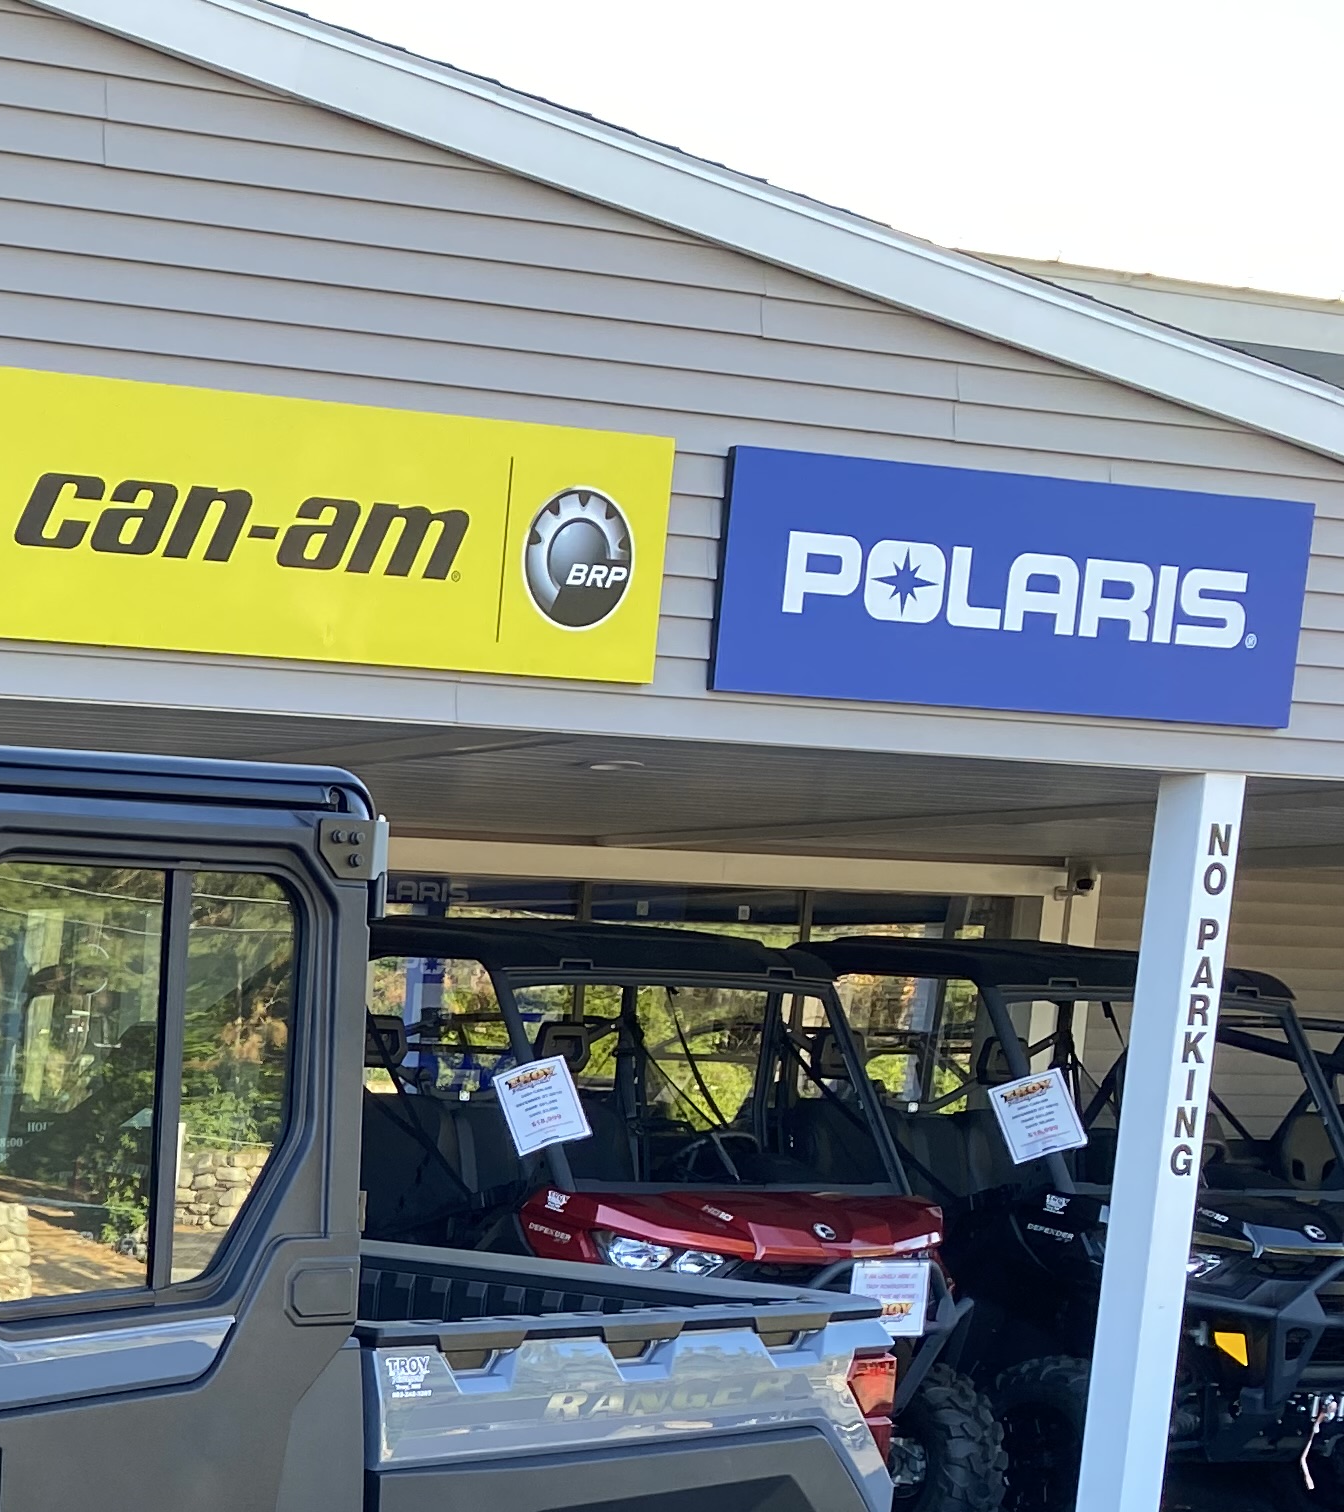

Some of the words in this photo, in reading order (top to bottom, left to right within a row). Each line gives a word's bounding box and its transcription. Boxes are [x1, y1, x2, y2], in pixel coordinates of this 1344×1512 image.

[14, 471, 470, 582] can-am
[563, 561, 627, 592] BRP
[781, 528, 1249, 648] POLARIS
[1203, 822, 1232, 897] NO
[1170, 917, 1220, 1177] PARKING
[1027, 1222, 1075, 1240] DEFENDER
[386, 1356, 430, 1375] TROY
[542, 1370, 793, 1421] RANGER
